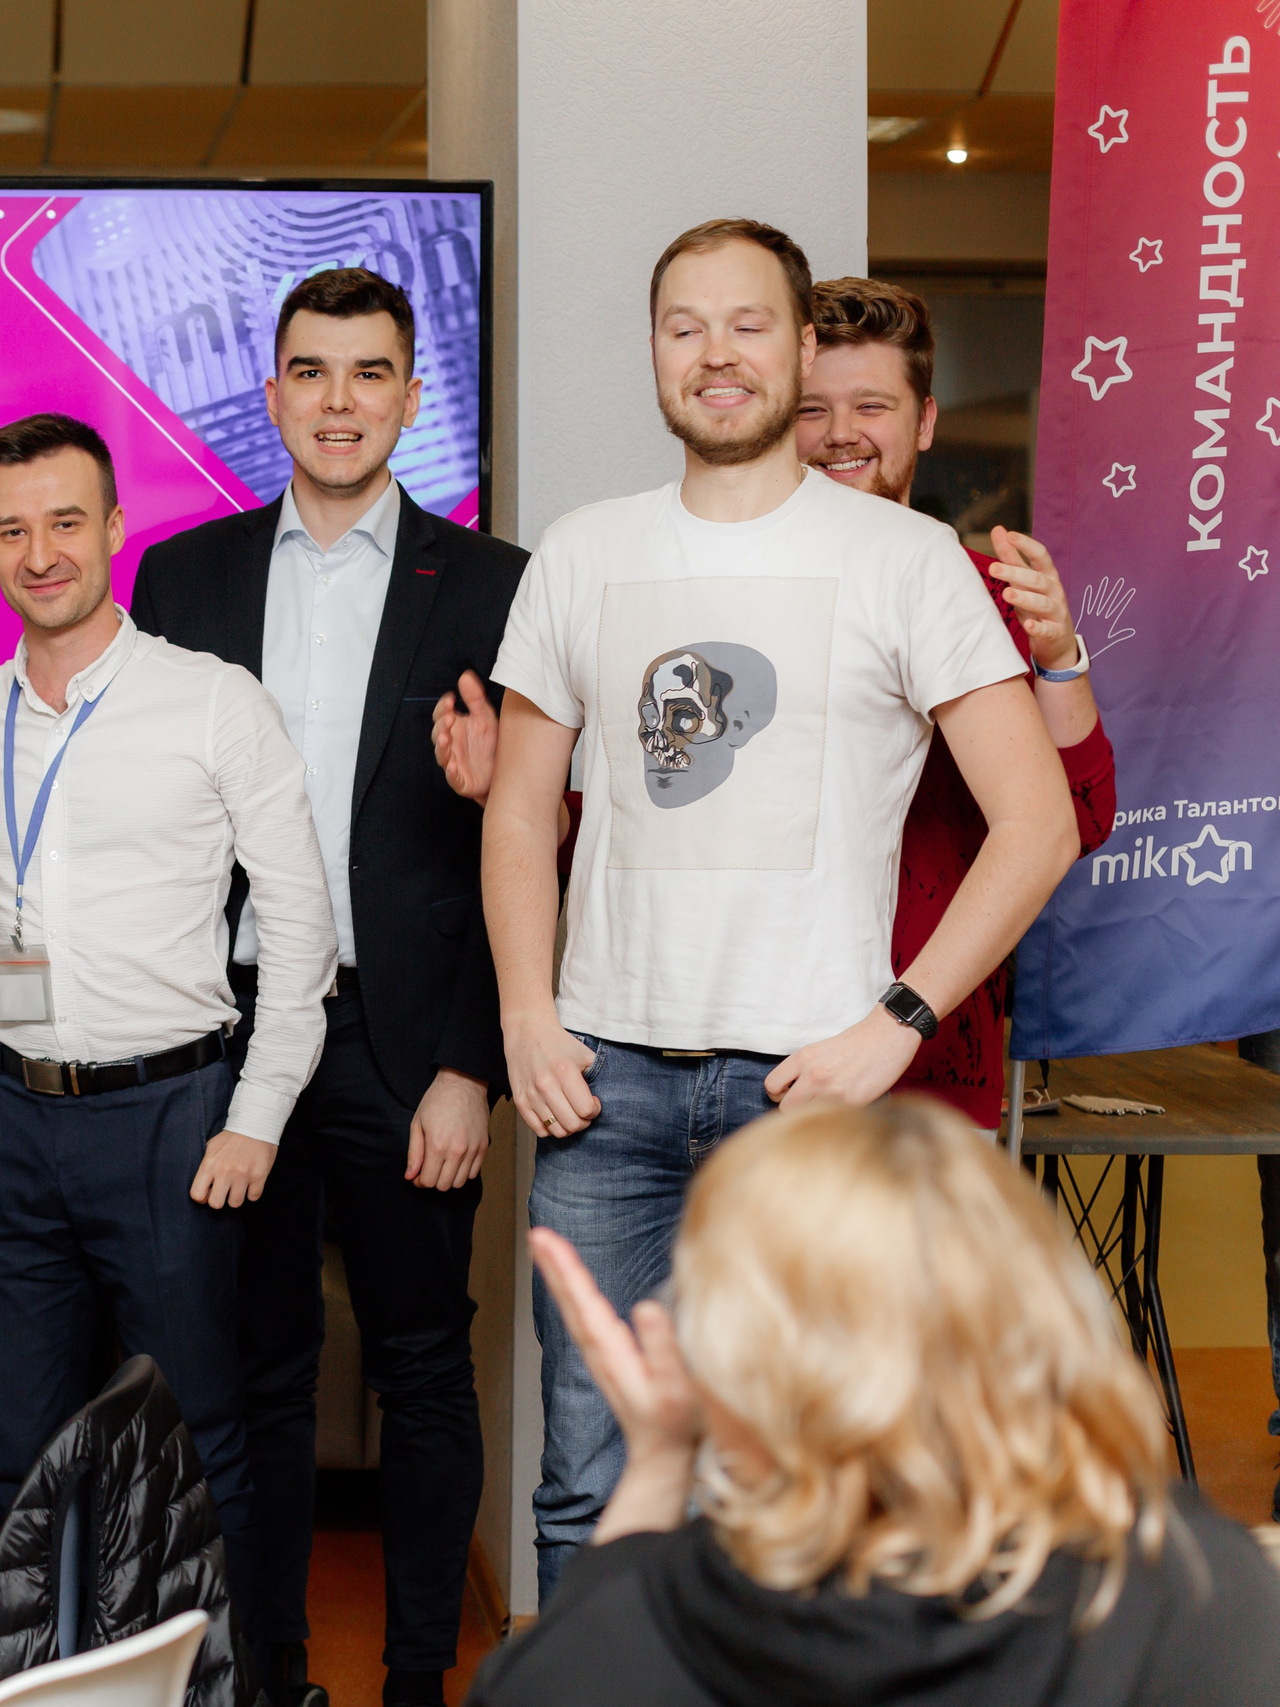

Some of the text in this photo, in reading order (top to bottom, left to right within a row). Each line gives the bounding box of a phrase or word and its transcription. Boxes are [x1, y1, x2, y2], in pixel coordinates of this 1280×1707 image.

[1187, 35, 1251, 552] КОМАНДНОСТЬ
[1112, 795, 1280, 832] рика Таланто
